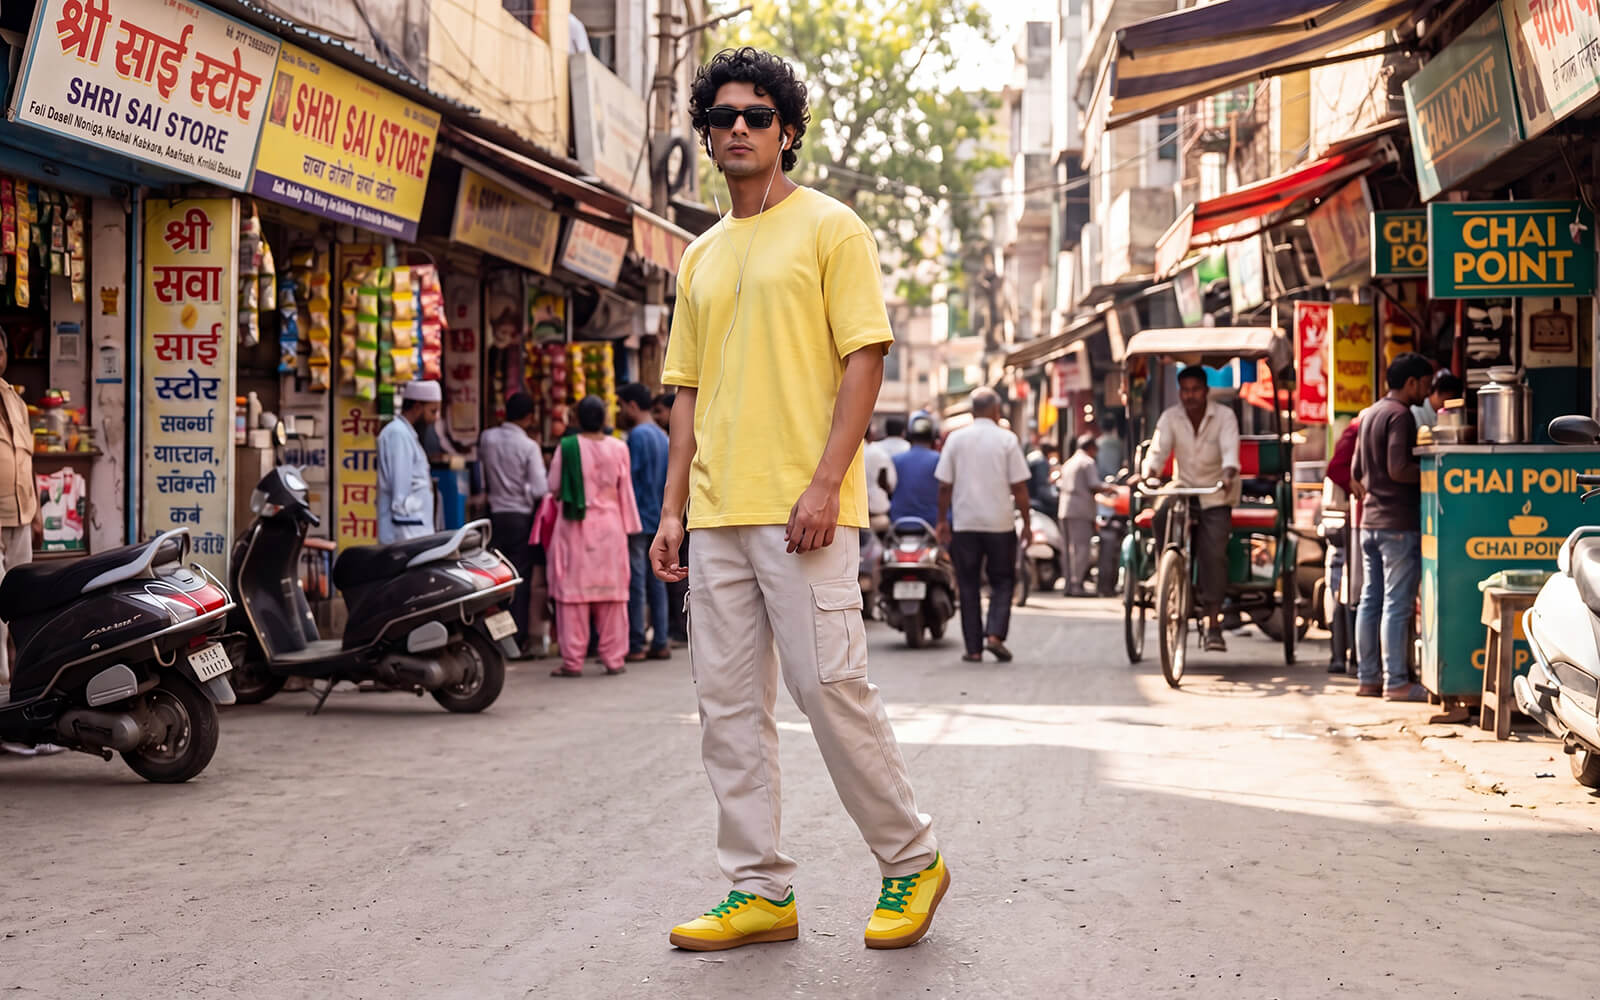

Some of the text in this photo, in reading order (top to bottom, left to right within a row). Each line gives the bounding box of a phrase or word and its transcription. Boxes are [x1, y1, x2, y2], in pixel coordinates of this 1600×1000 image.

[56, 0, 262, 121] श्री साई स्टोर
[67, 77, 229, 154] SHRI SAI STORE
[1417, 93, 1451, 156] CHAI
[1450, 56, 1499, 139] POINT
[292, 83, 341, 146] SHRI
[343, 104, 376, 158] SAI
[375, 118, 430, 179] STORE
[165, 208, 211, 251] श्री
[1462, 215, 1556, 249] CHAI
[153, 266, 222, 303] सवा
[1454, 250, 1573, 283] POINT
[153, 322, 222, 365] साई
[154, 368, 221, 400] स्टोर
[1443, 468, 1514, 494] CHAI
[1474, 541, 1518, 556] CHAI
